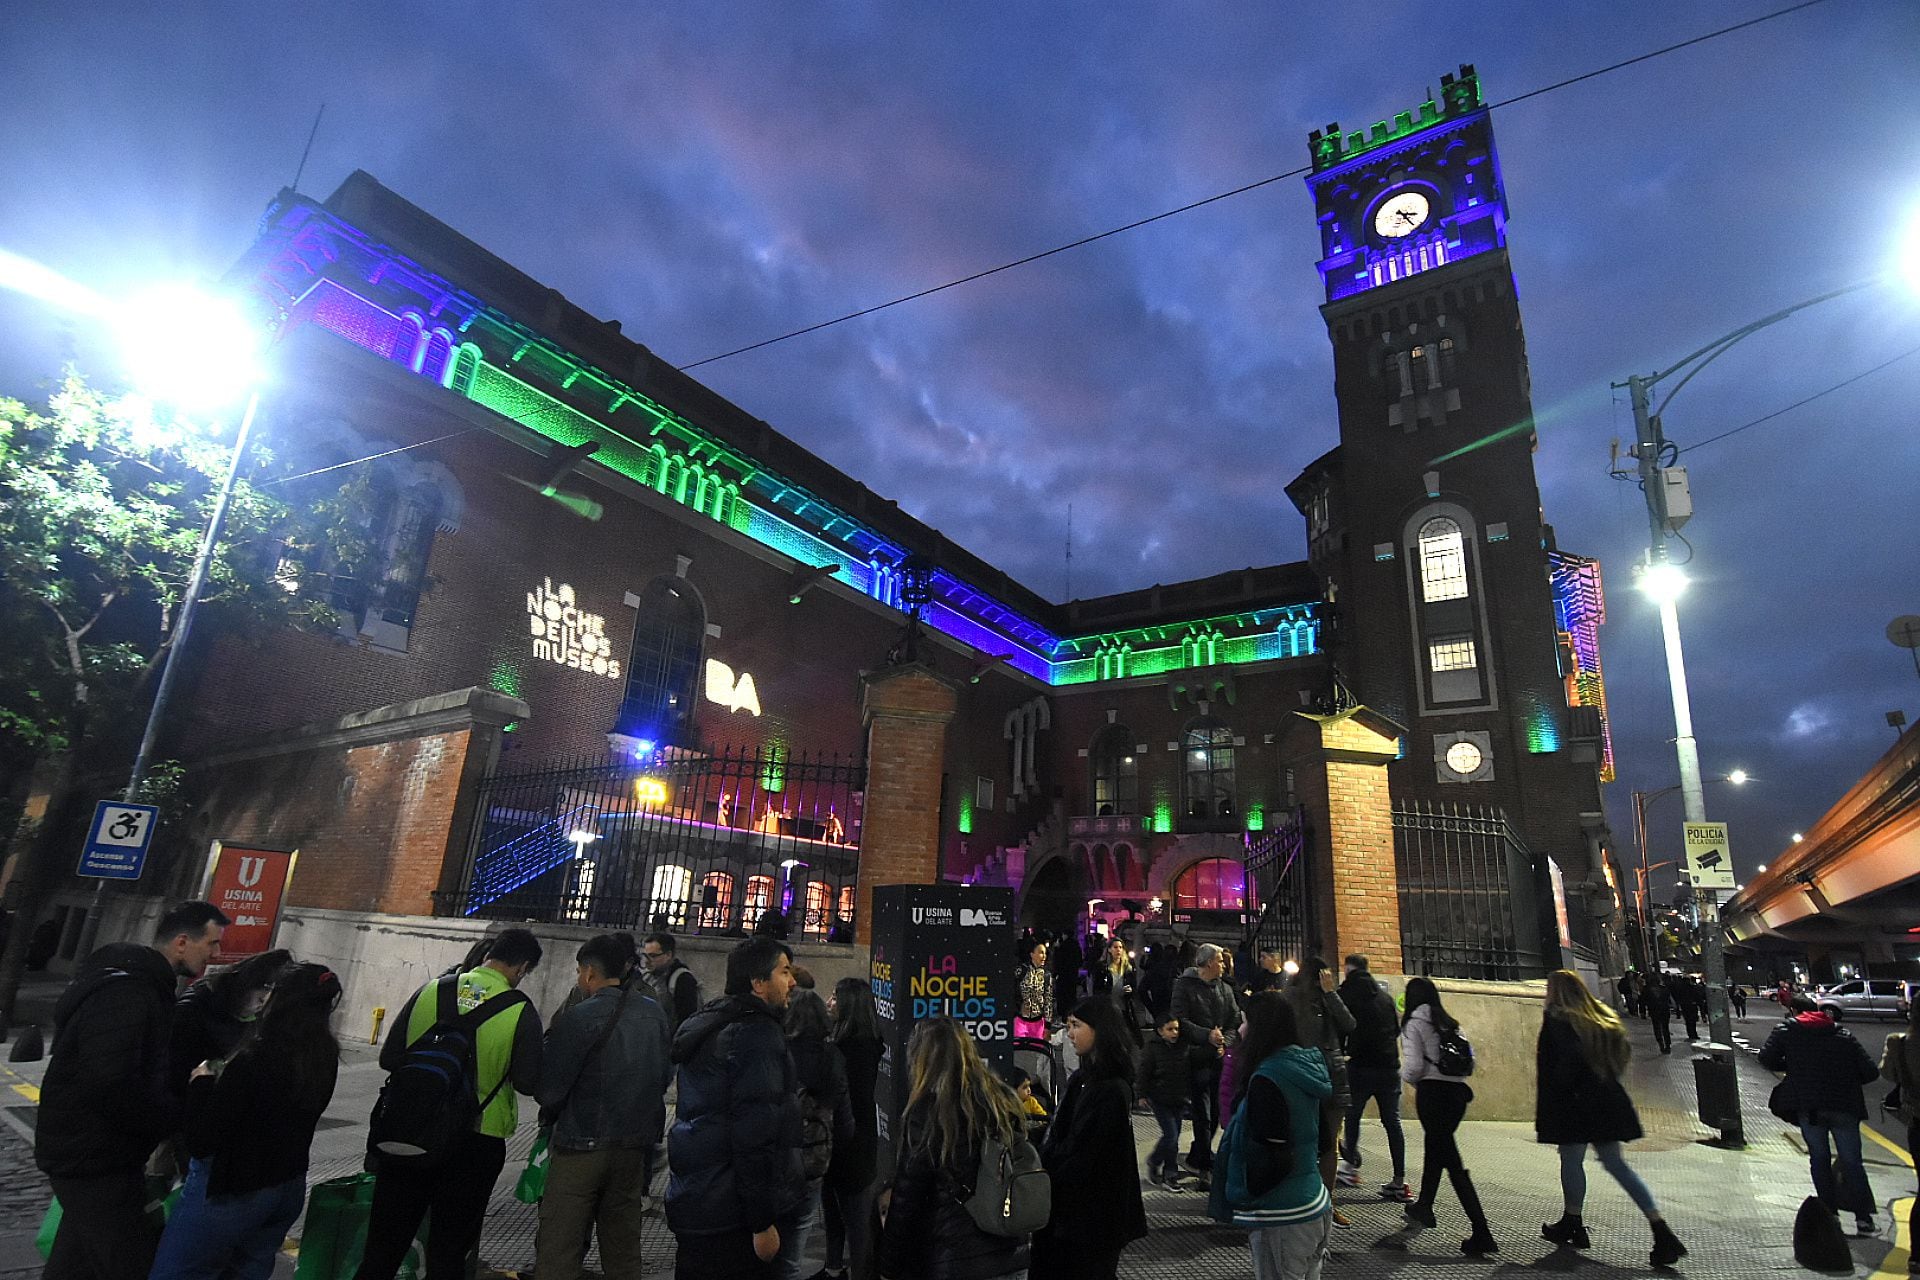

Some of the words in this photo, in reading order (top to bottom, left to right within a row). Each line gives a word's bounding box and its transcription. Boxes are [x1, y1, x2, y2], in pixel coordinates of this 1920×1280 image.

[527, 586, 605, 636] NOCHE
[531, 614, 561, 642] DE
[569, 627, 612, 657] LOS
[706, 658, 761, 717] BA
[224, 889, 263, 902] USINA
[926, 907, 952, 917] USINA
[960, 908, 988, 927] BA
[929, 955, 958, 974] LA
[910, 967, 988, 1000] NOCHE
[913, 999, 941, 1018] DE
[952, 998, 995, 1018] LOS
